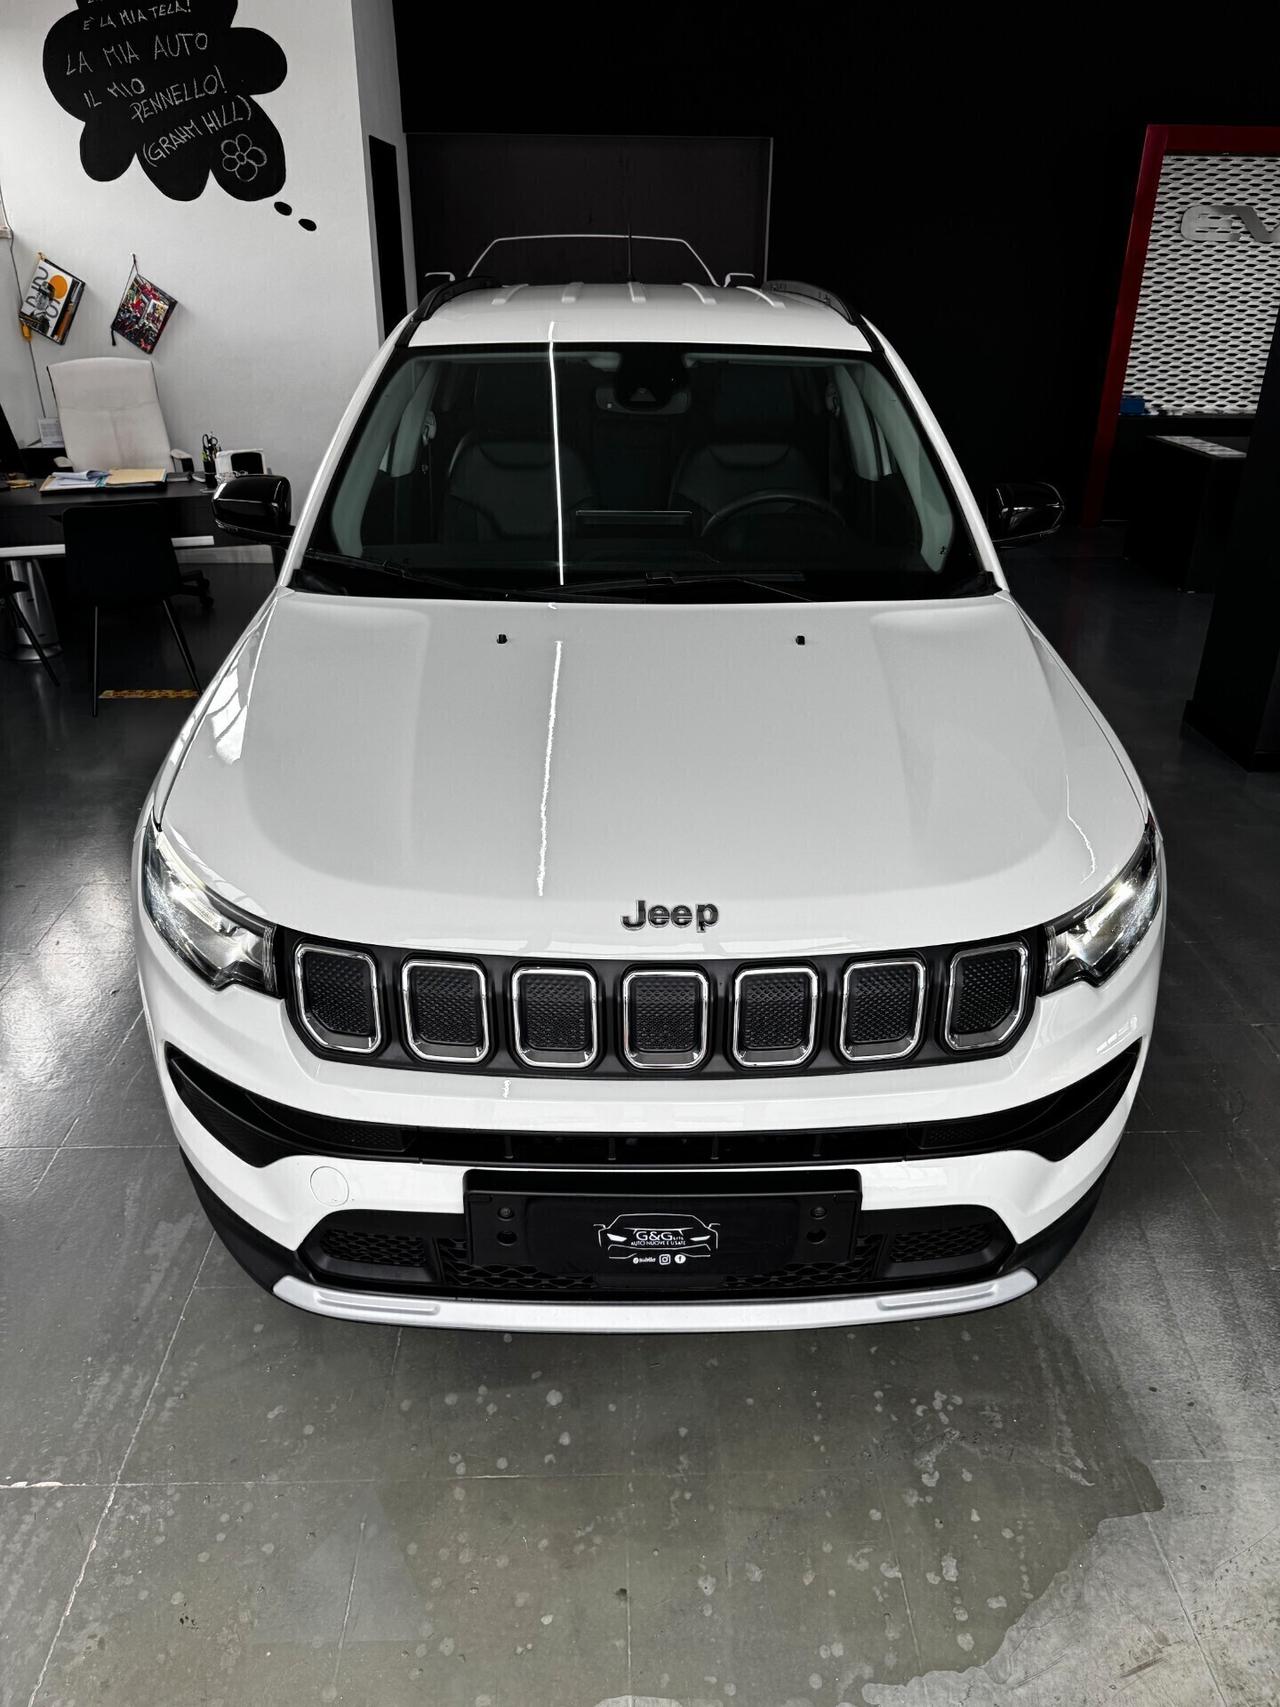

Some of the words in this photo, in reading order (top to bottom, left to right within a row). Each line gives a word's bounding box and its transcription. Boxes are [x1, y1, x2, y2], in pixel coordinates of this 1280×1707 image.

[100, 15, 117, 28] LA
[119, 9, 148, 26] MIA
[147, 0, 192, 19] TELA!
[66, 51, 93, 76] LA
[102, 41, 140, 66] MIA
[154, 32, 208, 60] AUTO
[83, 90, 102, 109] IL
[107, 77, 145, 98] MIO
[129, 65, 228, 124] PENNELLO!
[201, 94, 252, 135] HILL)
[620, 899, 719, 933] Jeep
[636, 1231, 673, 1241] G&G
